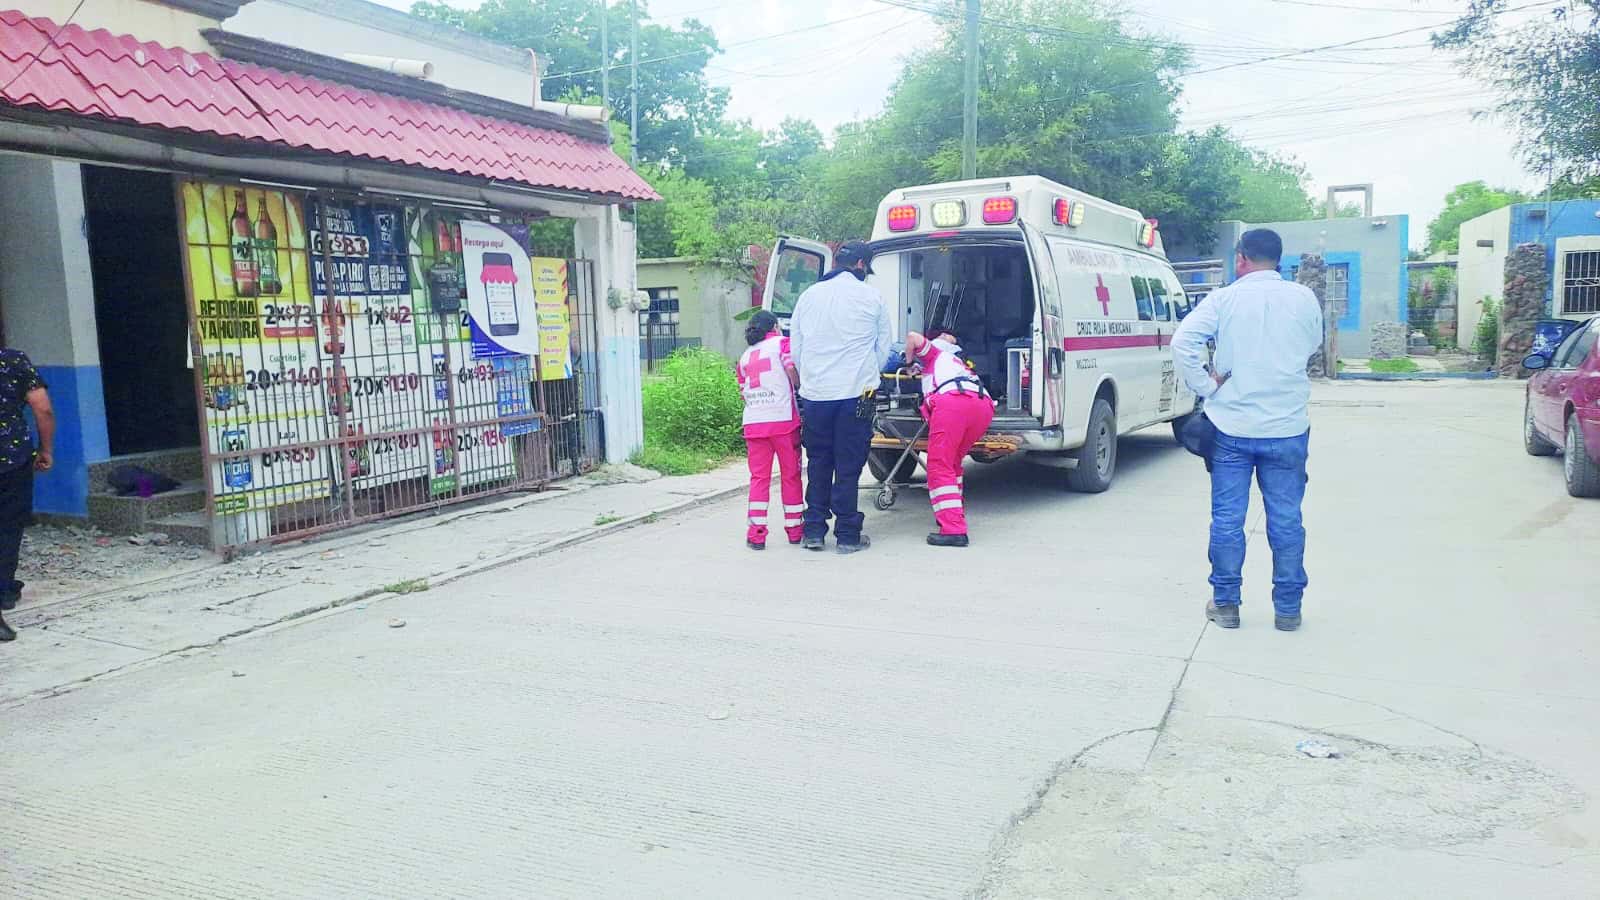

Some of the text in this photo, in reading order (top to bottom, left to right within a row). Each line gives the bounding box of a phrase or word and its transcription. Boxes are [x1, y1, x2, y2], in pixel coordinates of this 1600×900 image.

[200, 299, 256, 316] RETORNA
[264, 303, 315, 325] 2x$73
[366, 305, 412, 324] 1x$42
[1076, 321, 1092, 335] CRUZ
[245, 366, 321, 391] 20x$140
[353, 373, 418, 397] 20x$130
